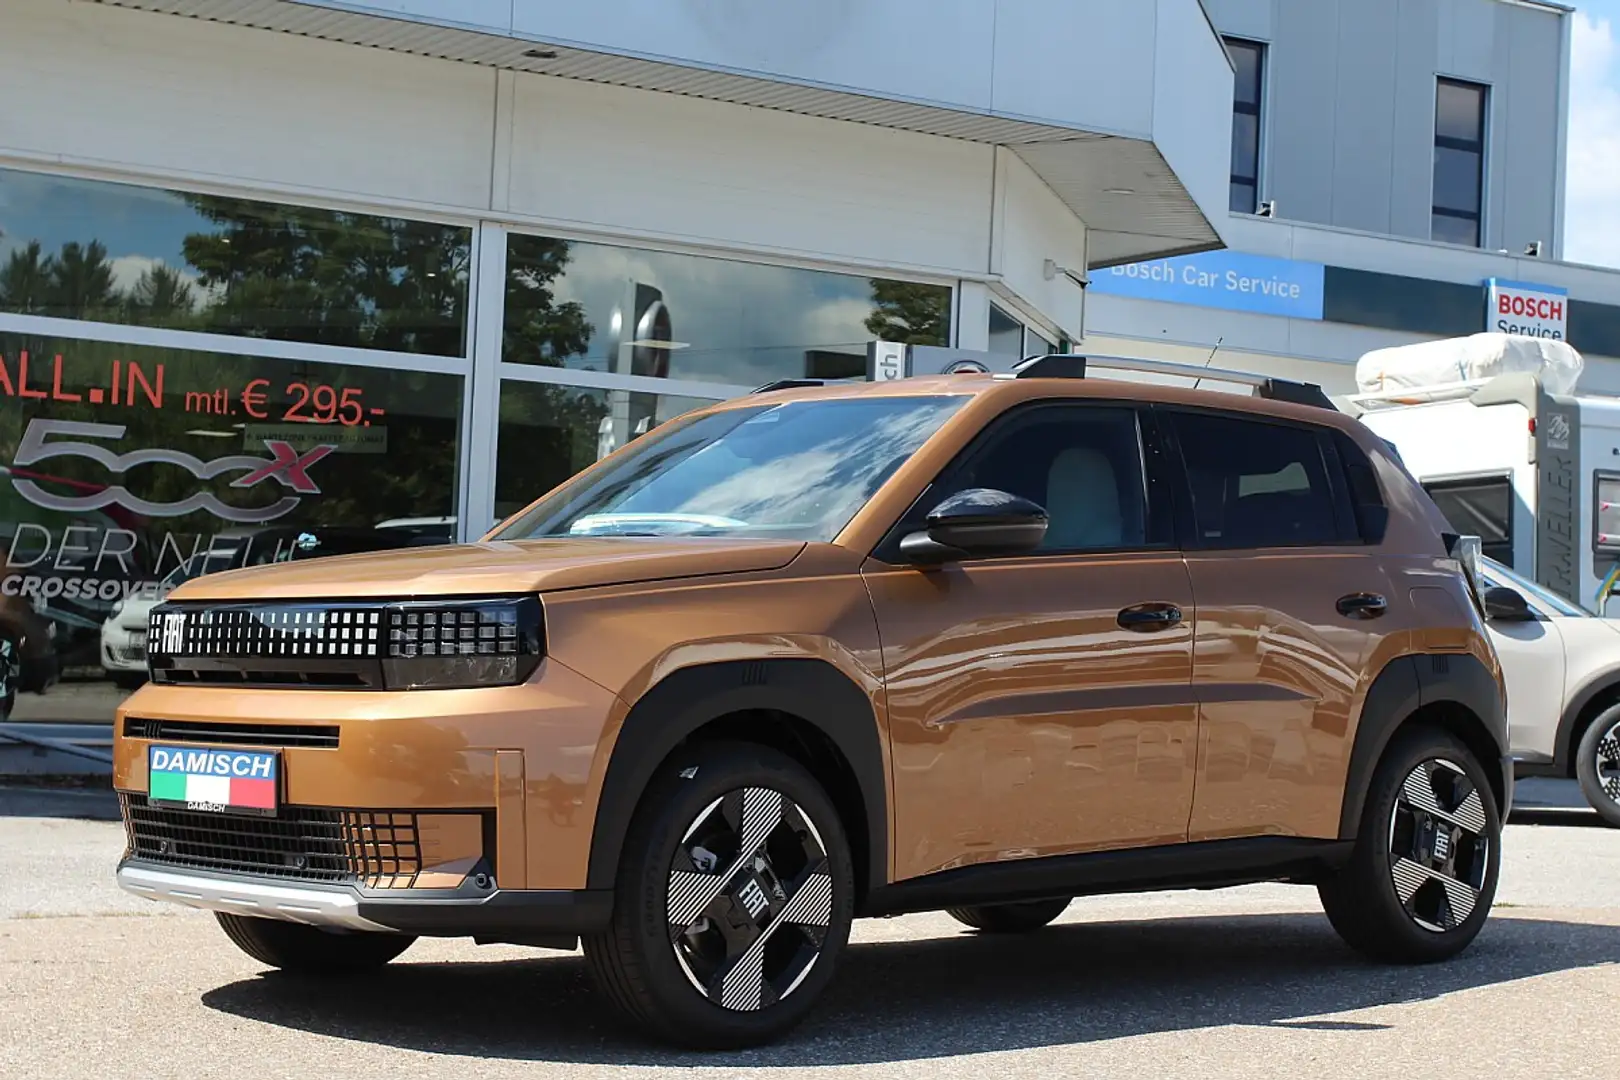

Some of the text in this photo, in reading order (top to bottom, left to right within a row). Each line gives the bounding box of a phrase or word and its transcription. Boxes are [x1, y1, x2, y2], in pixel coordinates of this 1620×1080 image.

[1182, 265, 1219, 288] Car
[1225, 270, 1300, 298] Service
[1498, 294, 1562, 321] BOSCH
[185, 388, 236, 416] mtl.
[241, 378, 270, 418] €
[5, 522, 138, 574] DER
[162, 613, 187, 653] FIAT
[151, 750, 272, 777] DAMISCH
[187, 801, 226, 813] DAMISCH
[1433, 828, 1449, 860] FIAT
[738, 878, 769, 919] FIAT
